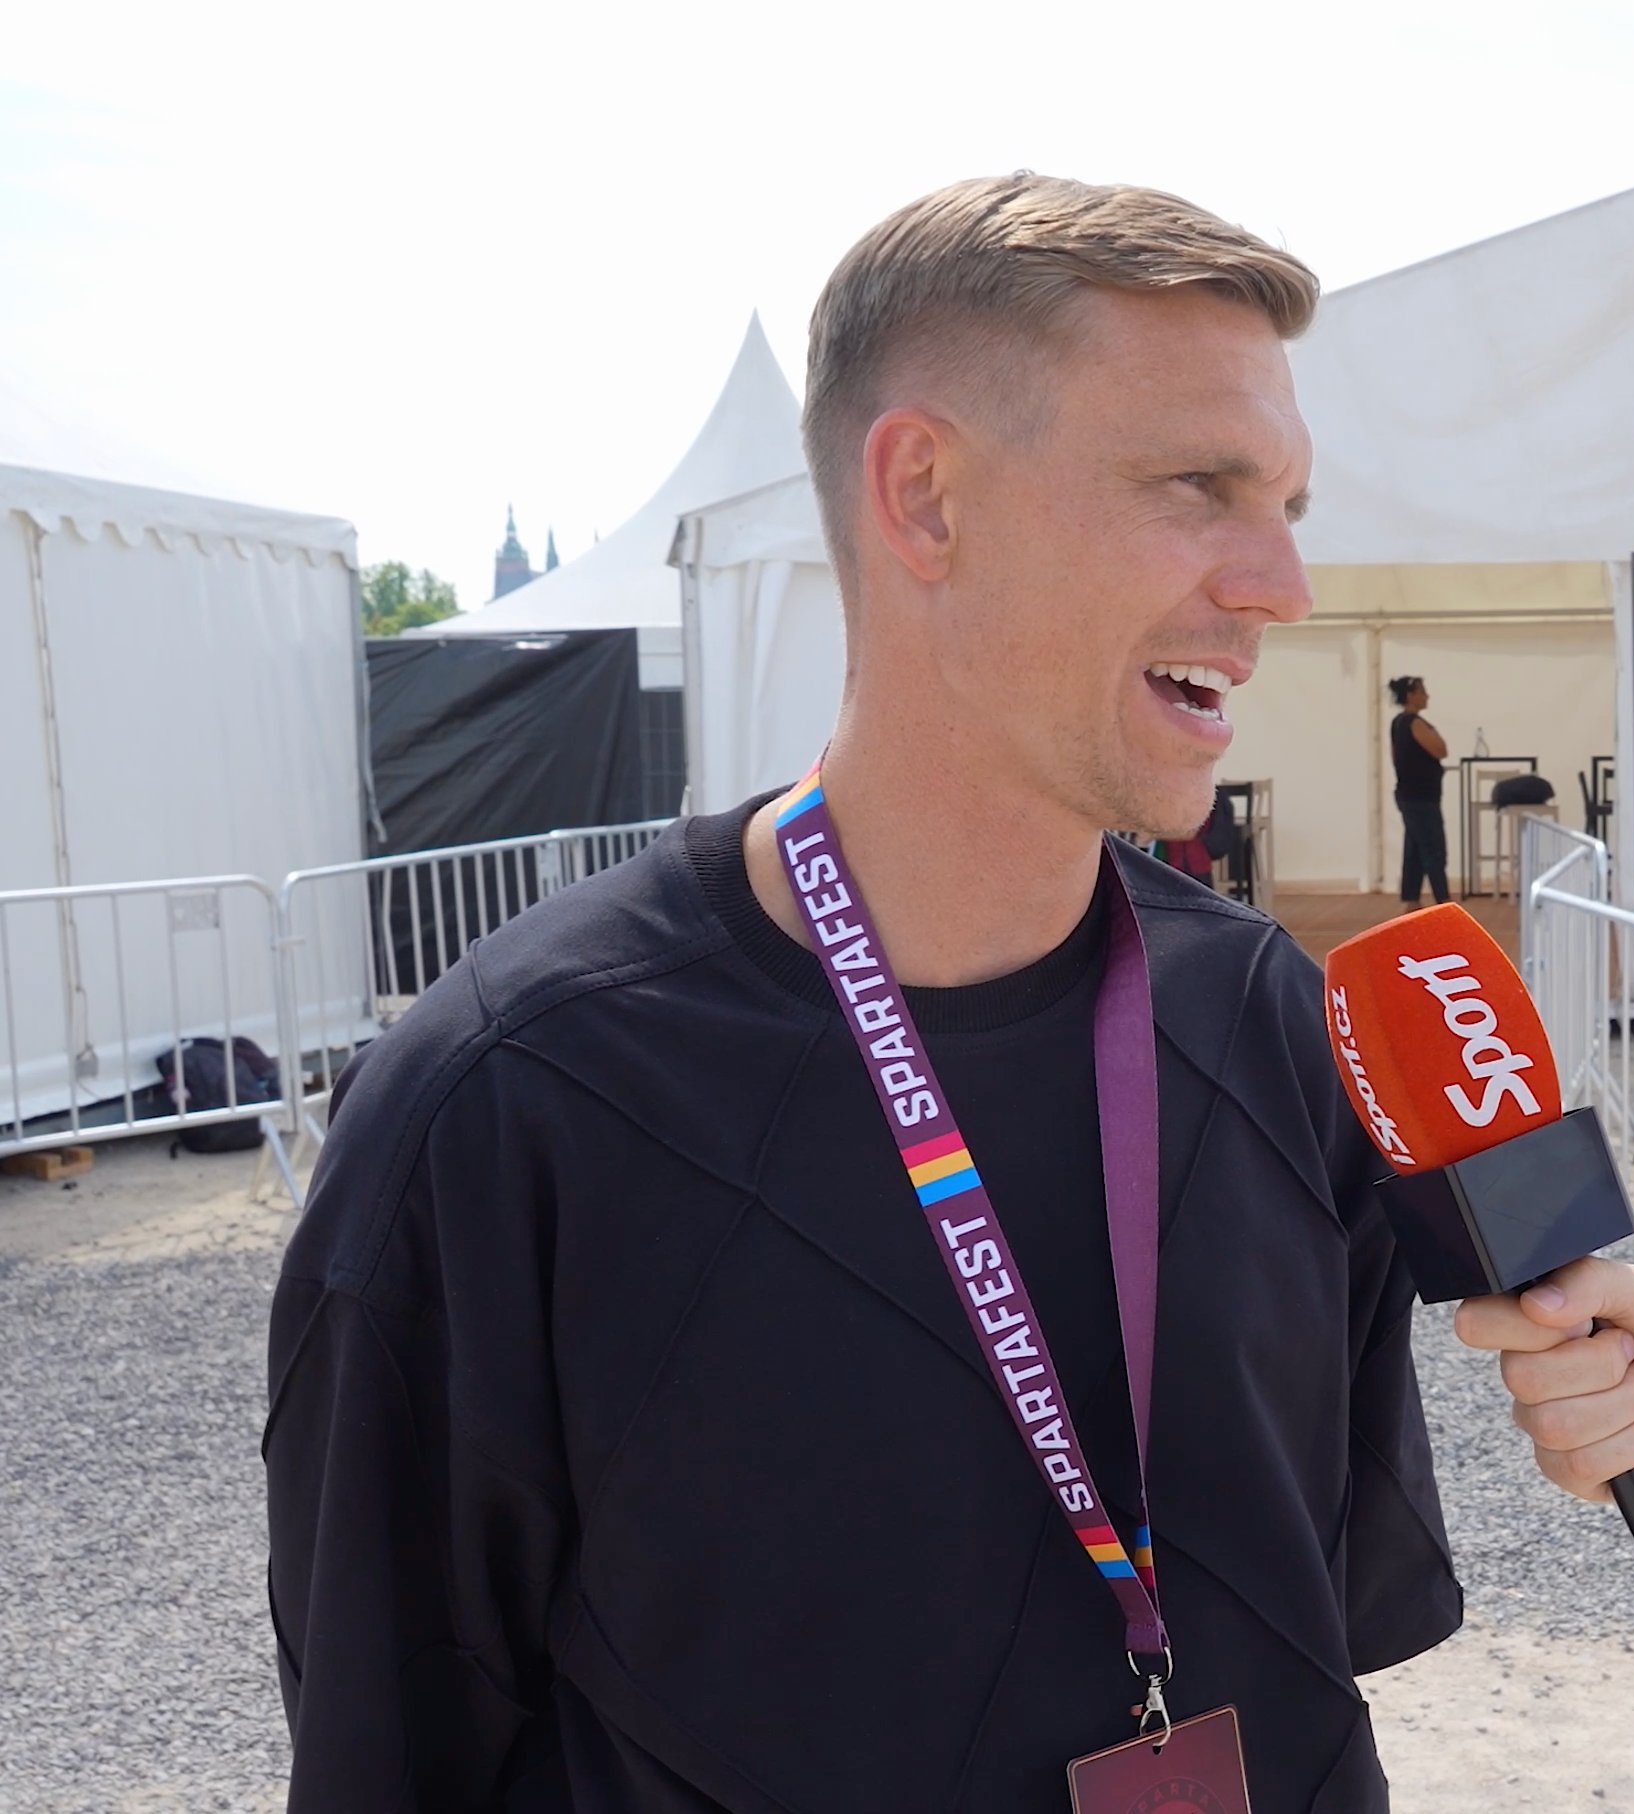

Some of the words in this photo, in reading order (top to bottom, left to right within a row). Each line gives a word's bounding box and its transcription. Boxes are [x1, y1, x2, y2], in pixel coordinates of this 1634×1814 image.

[785, 831, 939, 1127] SPARTAFEST
[1397, 953, 1542, 1128] Sport
[940, 1215, 1095, 1513] SPARTAFEST
[1137, 1782, 1210, 1814] PARTA
